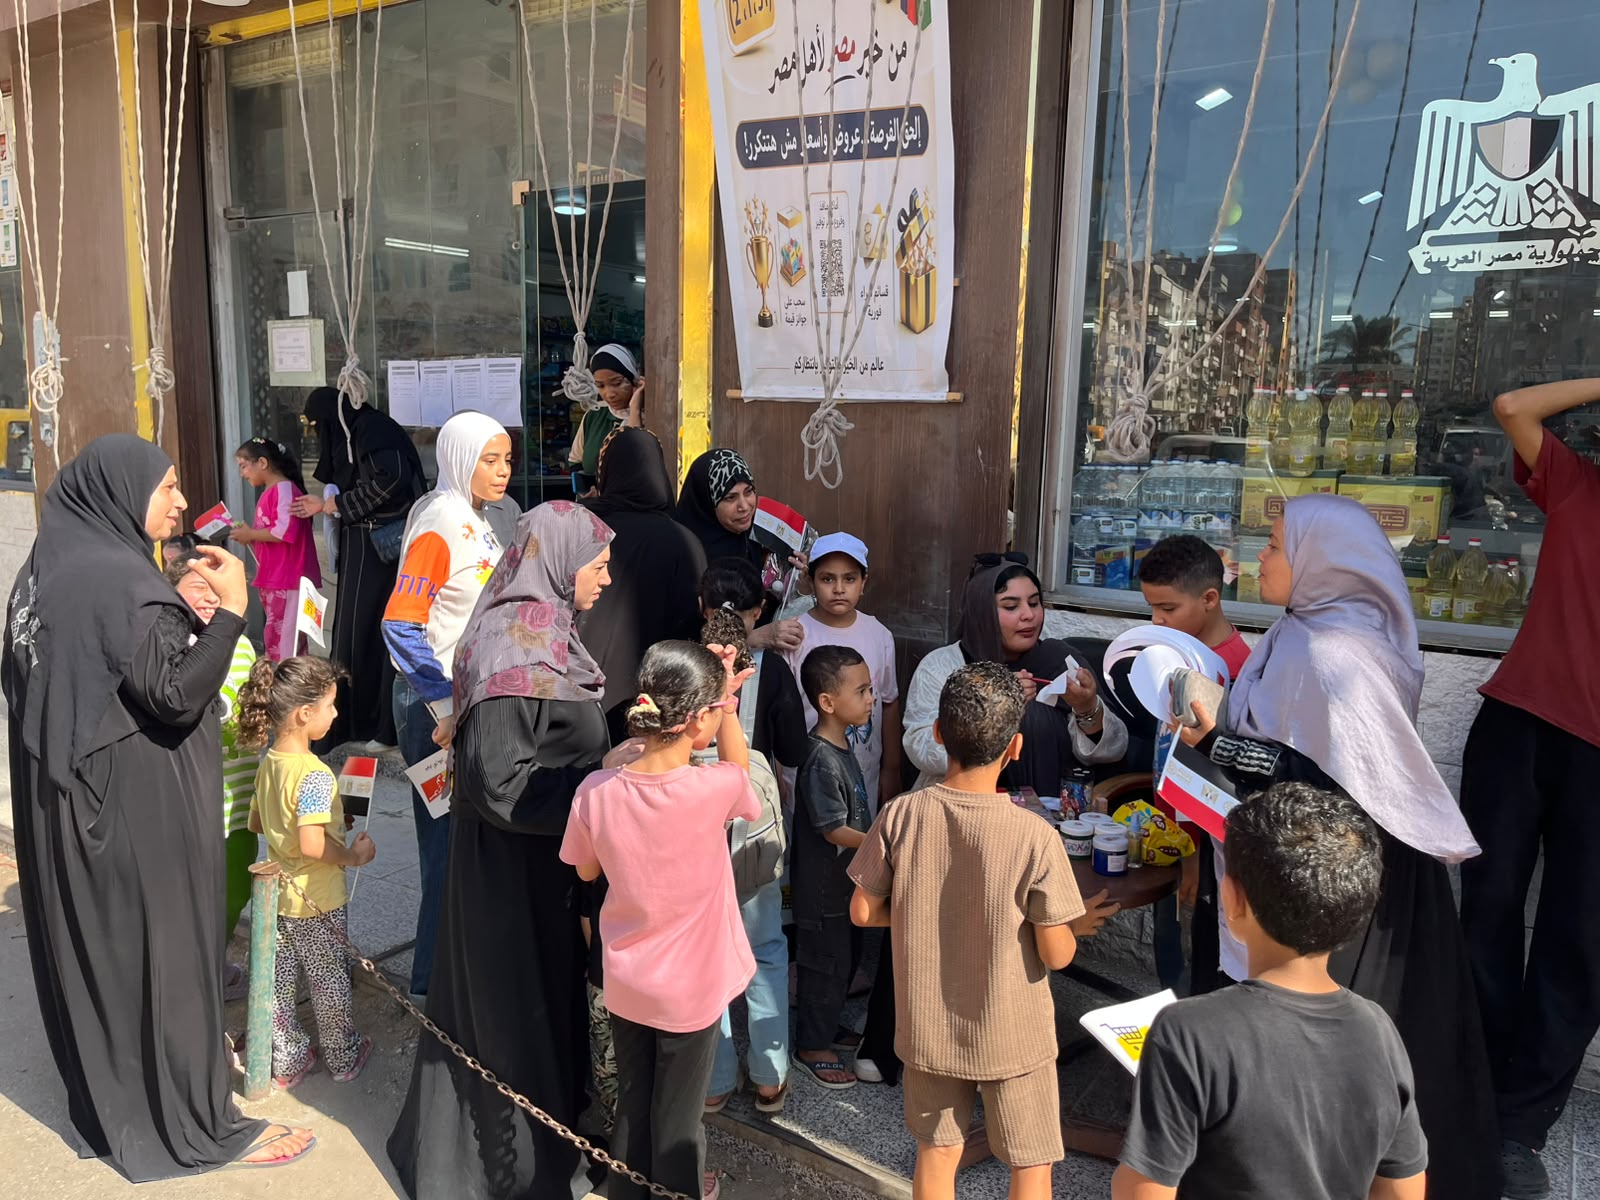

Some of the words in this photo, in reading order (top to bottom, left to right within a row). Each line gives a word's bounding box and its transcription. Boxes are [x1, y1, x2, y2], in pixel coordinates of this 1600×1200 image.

[768, 51, 798, 95] مصر
[888, 40, 907, 82] من
[780, 128, 797, 159] مش
[1484, 249, 1522, 267] مصر
